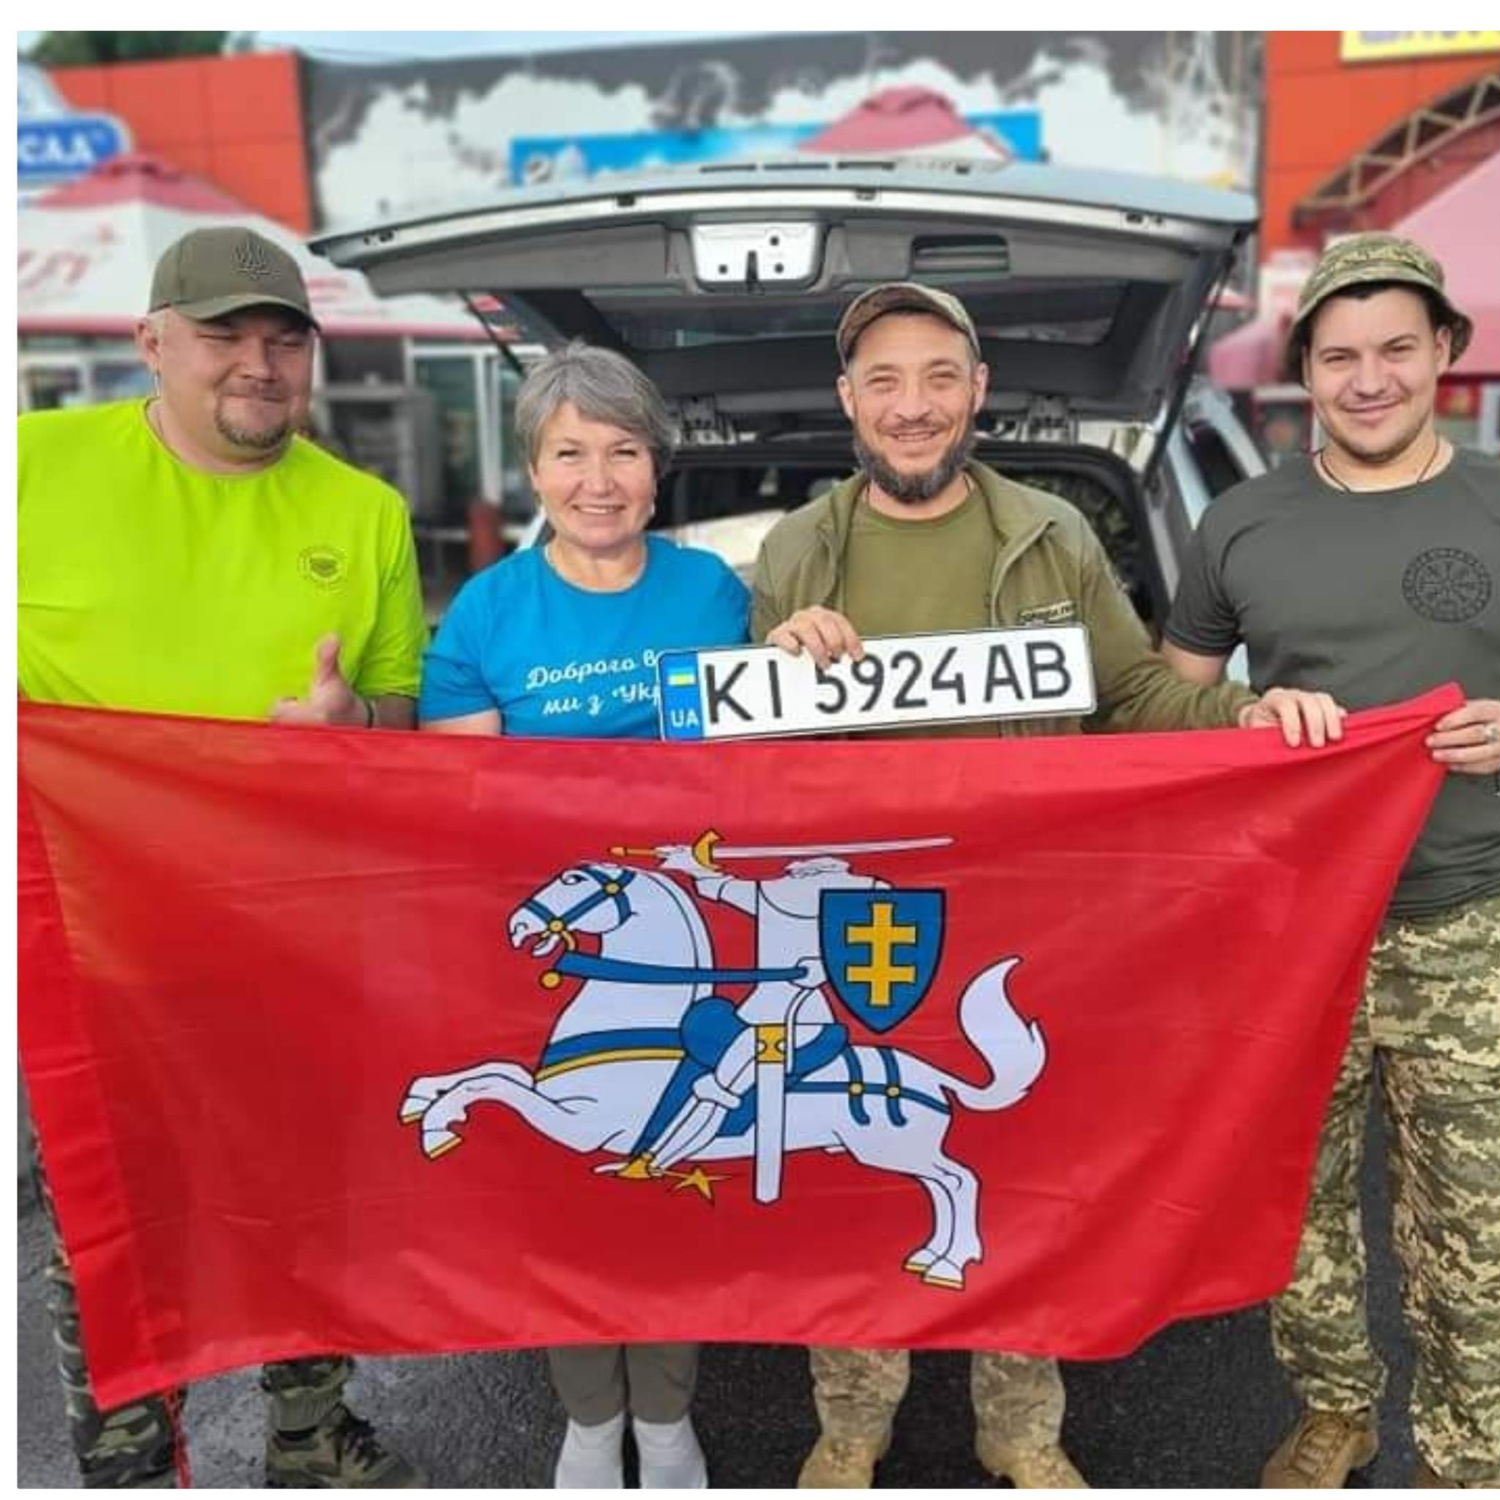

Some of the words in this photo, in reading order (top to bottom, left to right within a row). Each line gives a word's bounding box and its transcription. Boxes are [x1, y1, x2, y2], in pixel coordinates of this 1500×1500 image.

[526, 659, 637, 690] Доброго
[704, 659, 784, 724] KI
[815, 646, 966, 715] 5924
[984, 640, 1072, 703] AB
[543, 697, 582, 715] ми
[670, 709, 699, 728] UA
